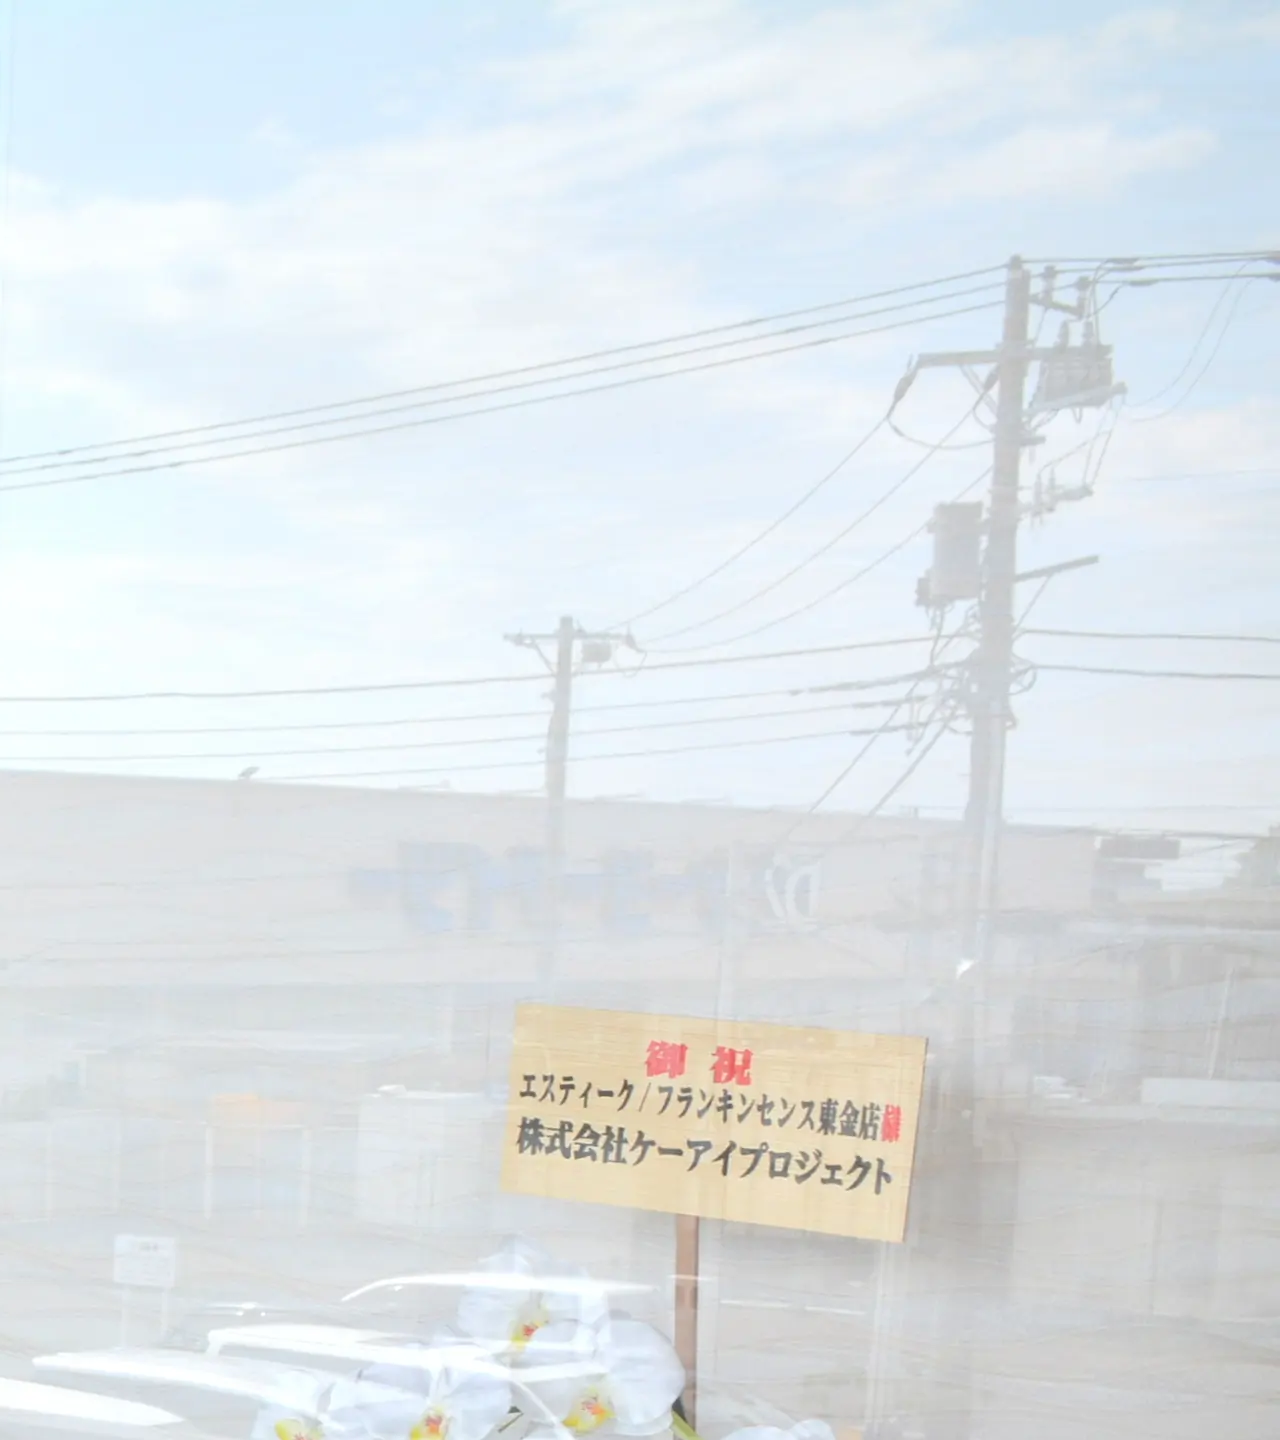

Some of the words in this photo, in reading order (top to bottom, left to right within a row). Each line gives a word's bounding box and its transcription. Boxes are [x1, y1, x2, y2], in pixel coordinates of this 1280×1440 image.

[516, 1116, 893, 1196] 株式会社ケーアイプロジェクト
